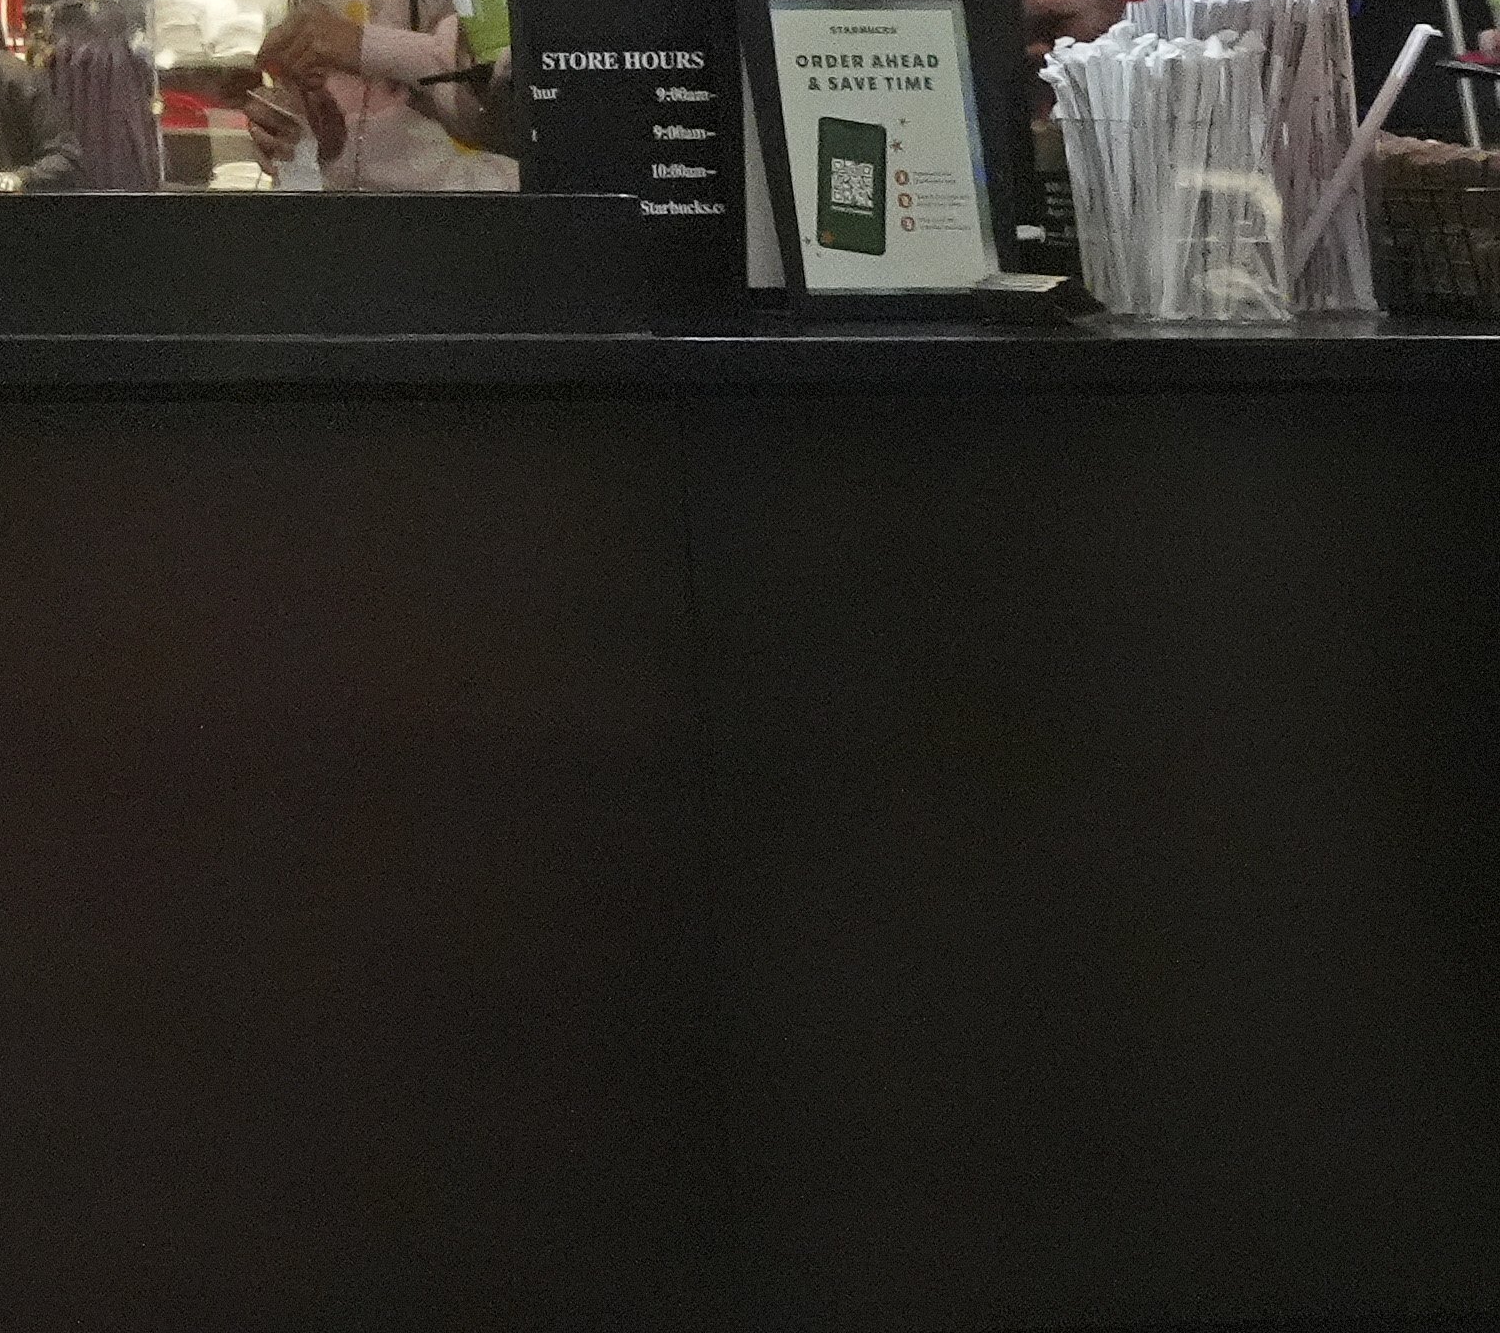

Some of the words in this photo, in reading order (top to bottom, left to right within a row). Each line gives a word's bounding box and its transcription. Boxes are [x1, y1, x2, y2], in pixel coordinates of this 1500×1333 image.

[542, 51, 619, 70] STORE
[624, 51, 704, 70] HOURS
[795, 54, 864, 69] ORDER
[871, 54, 939, 69] AHEAD
[807, 77, 821, 91] &
[828, 77, 878, 91] SAVE
[885, 77, 935, 91] TIME
